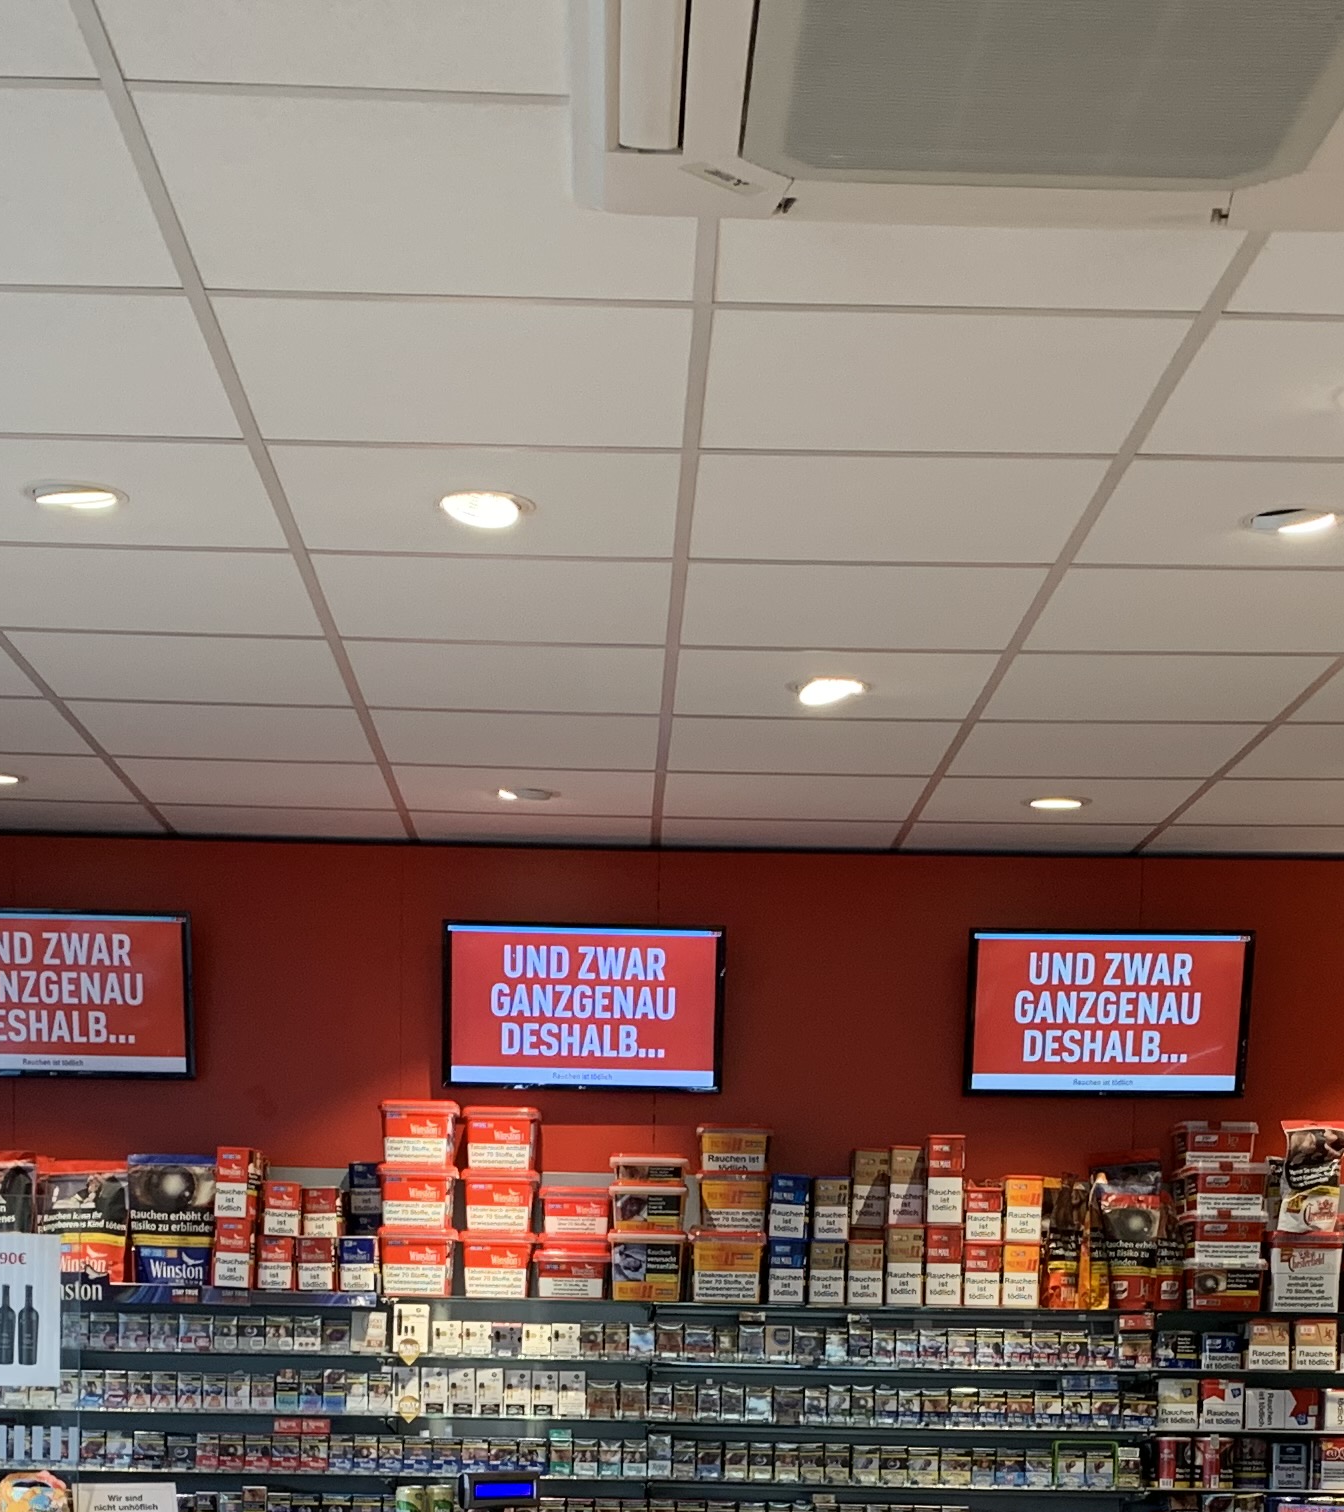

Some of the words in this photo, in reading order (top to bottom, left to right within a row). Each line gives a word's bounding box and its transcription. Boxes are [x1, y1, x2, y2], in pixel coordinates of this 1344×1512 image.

[42, 932, 131, 967] ZWAR
[503, 944, 570, 979] UND
[578, 946, 666, 981] ZWAR
[1029, 952, 1096, 986] UND
[1103, 953, 1194, 986] ZWAR
[490, 982, 676, 1020] GANZGENAU
[1014, 990, 1202, 1025] GANZGENAU
[501, 1022, 665, 1058] DESHALB...
[1022, 1029, 1188, 1063] DESHALB...
[131, 1210, 167, 1221] Rauchen
[169, 1210, 201, 1222] erhöht
[131, 1221, 156, 1232] Risiko
[157, 1223, 167, 1231] zu
[150, 1259, 204, 1279] Winston
[107, 1494, 121, 1502] Wir
[125, 1494, 143, 1502] sind
[118, 1503, 159, 1511] unhöflich
